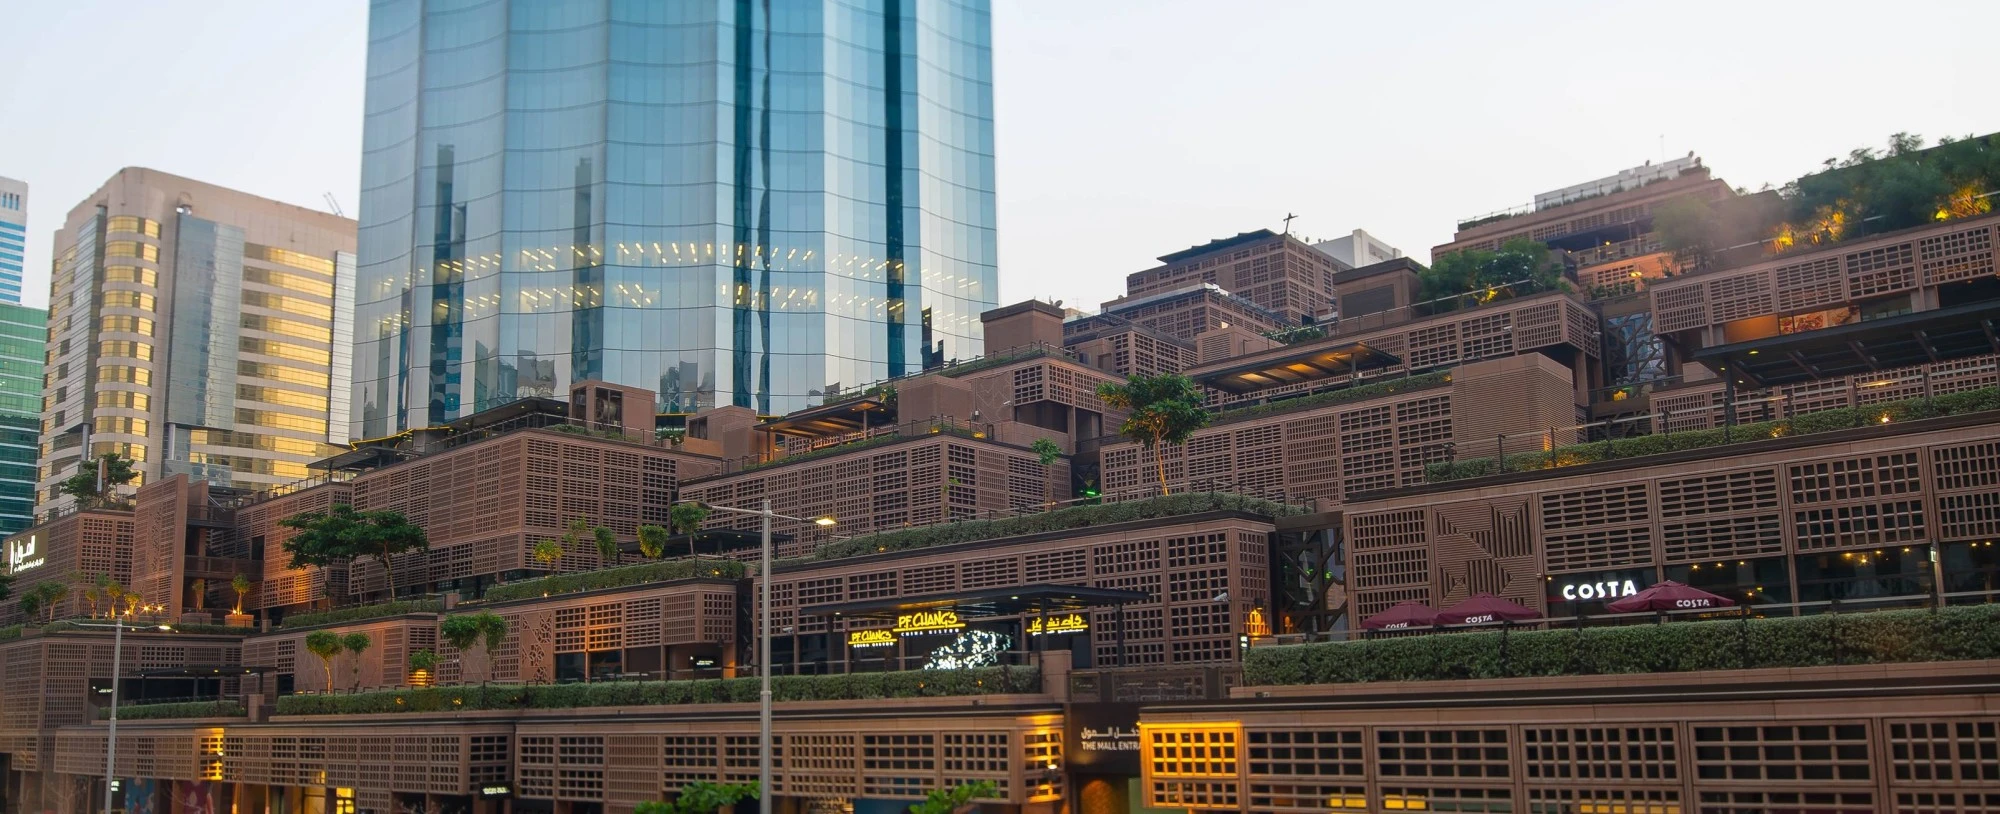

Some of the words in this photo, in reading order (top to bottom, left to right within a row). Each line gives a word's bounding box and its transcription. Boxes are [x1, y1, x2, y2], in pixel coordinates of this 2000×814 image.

[1562, 580, 1637, 600] COSTA
[1676, 599, 1710, 607] COSTA
[1465, 614, 1493, 624] COSTA
[1081, 741, 1096, 750] THE
[1097, 741, 1117, 750] MALL
